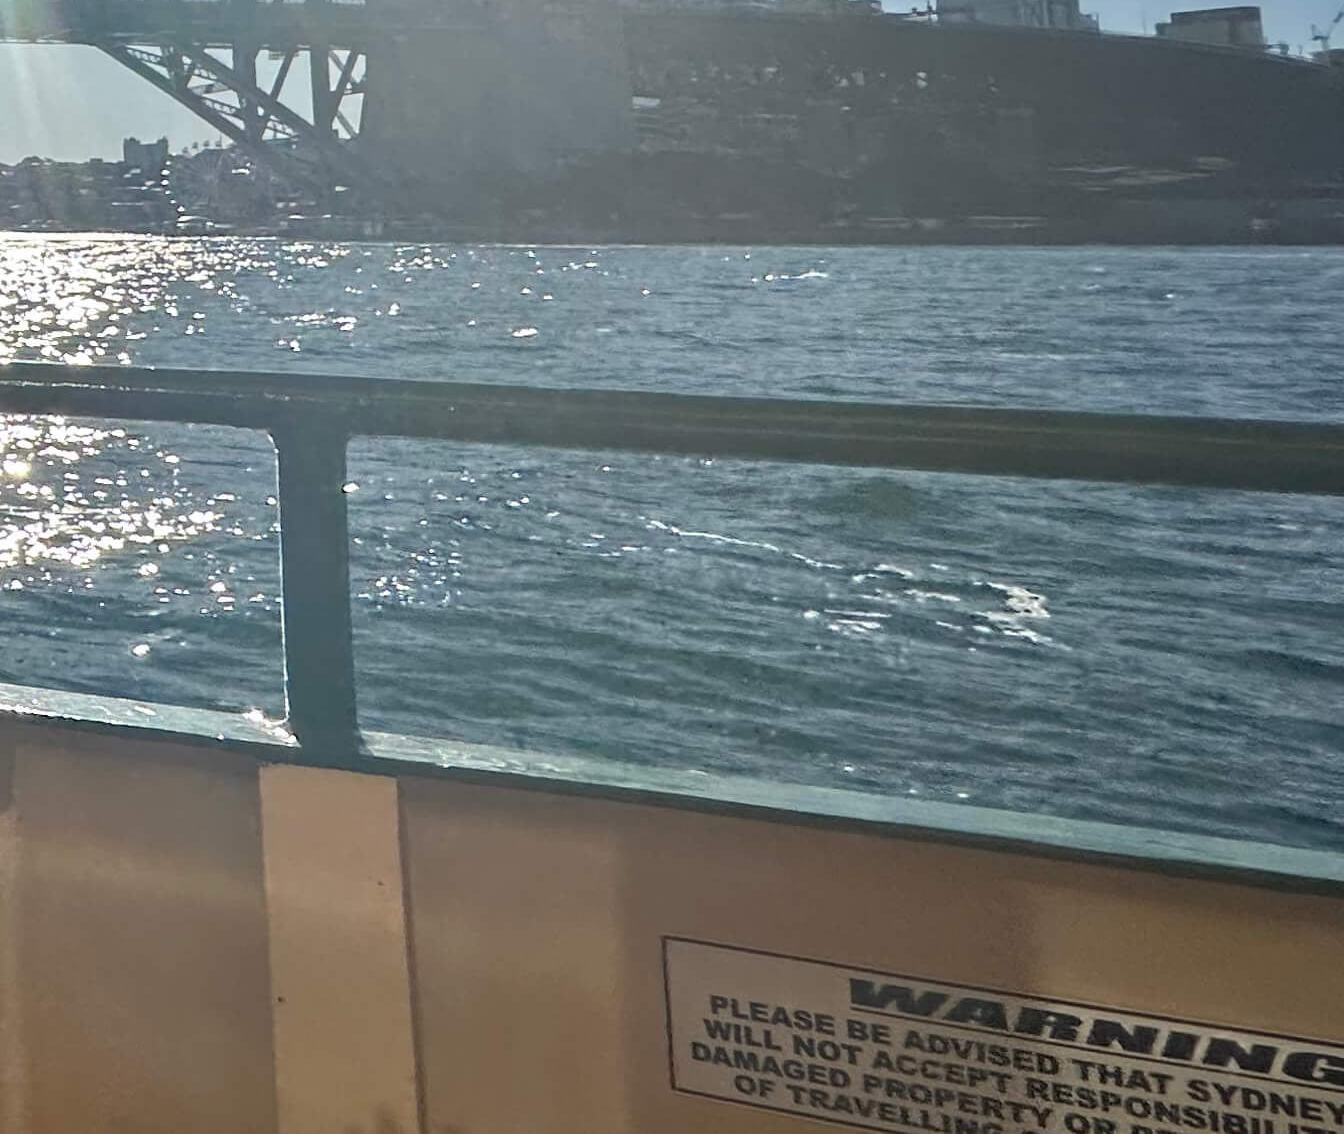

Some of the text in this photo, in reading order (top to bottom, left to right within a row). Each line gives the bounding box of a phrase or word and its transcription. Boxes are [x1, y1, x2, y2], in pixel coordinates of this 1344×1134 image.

[704, 1018, 782, 1051] WILL
[793, 1035, 862, 1064] NOT
[872, 1050, 1012, 1093] ACCEPT
[709, 994, 1344, 1126] PLEASE BE ADVISED THAT SYDNEY
[849, 977, 1344, 1087] WARNING
[691, 1041, 851, 1088] DAMAGED
[863, 1073, 1052, 1128] PROPERTY
[734, 1075, 776, 1097] OF
